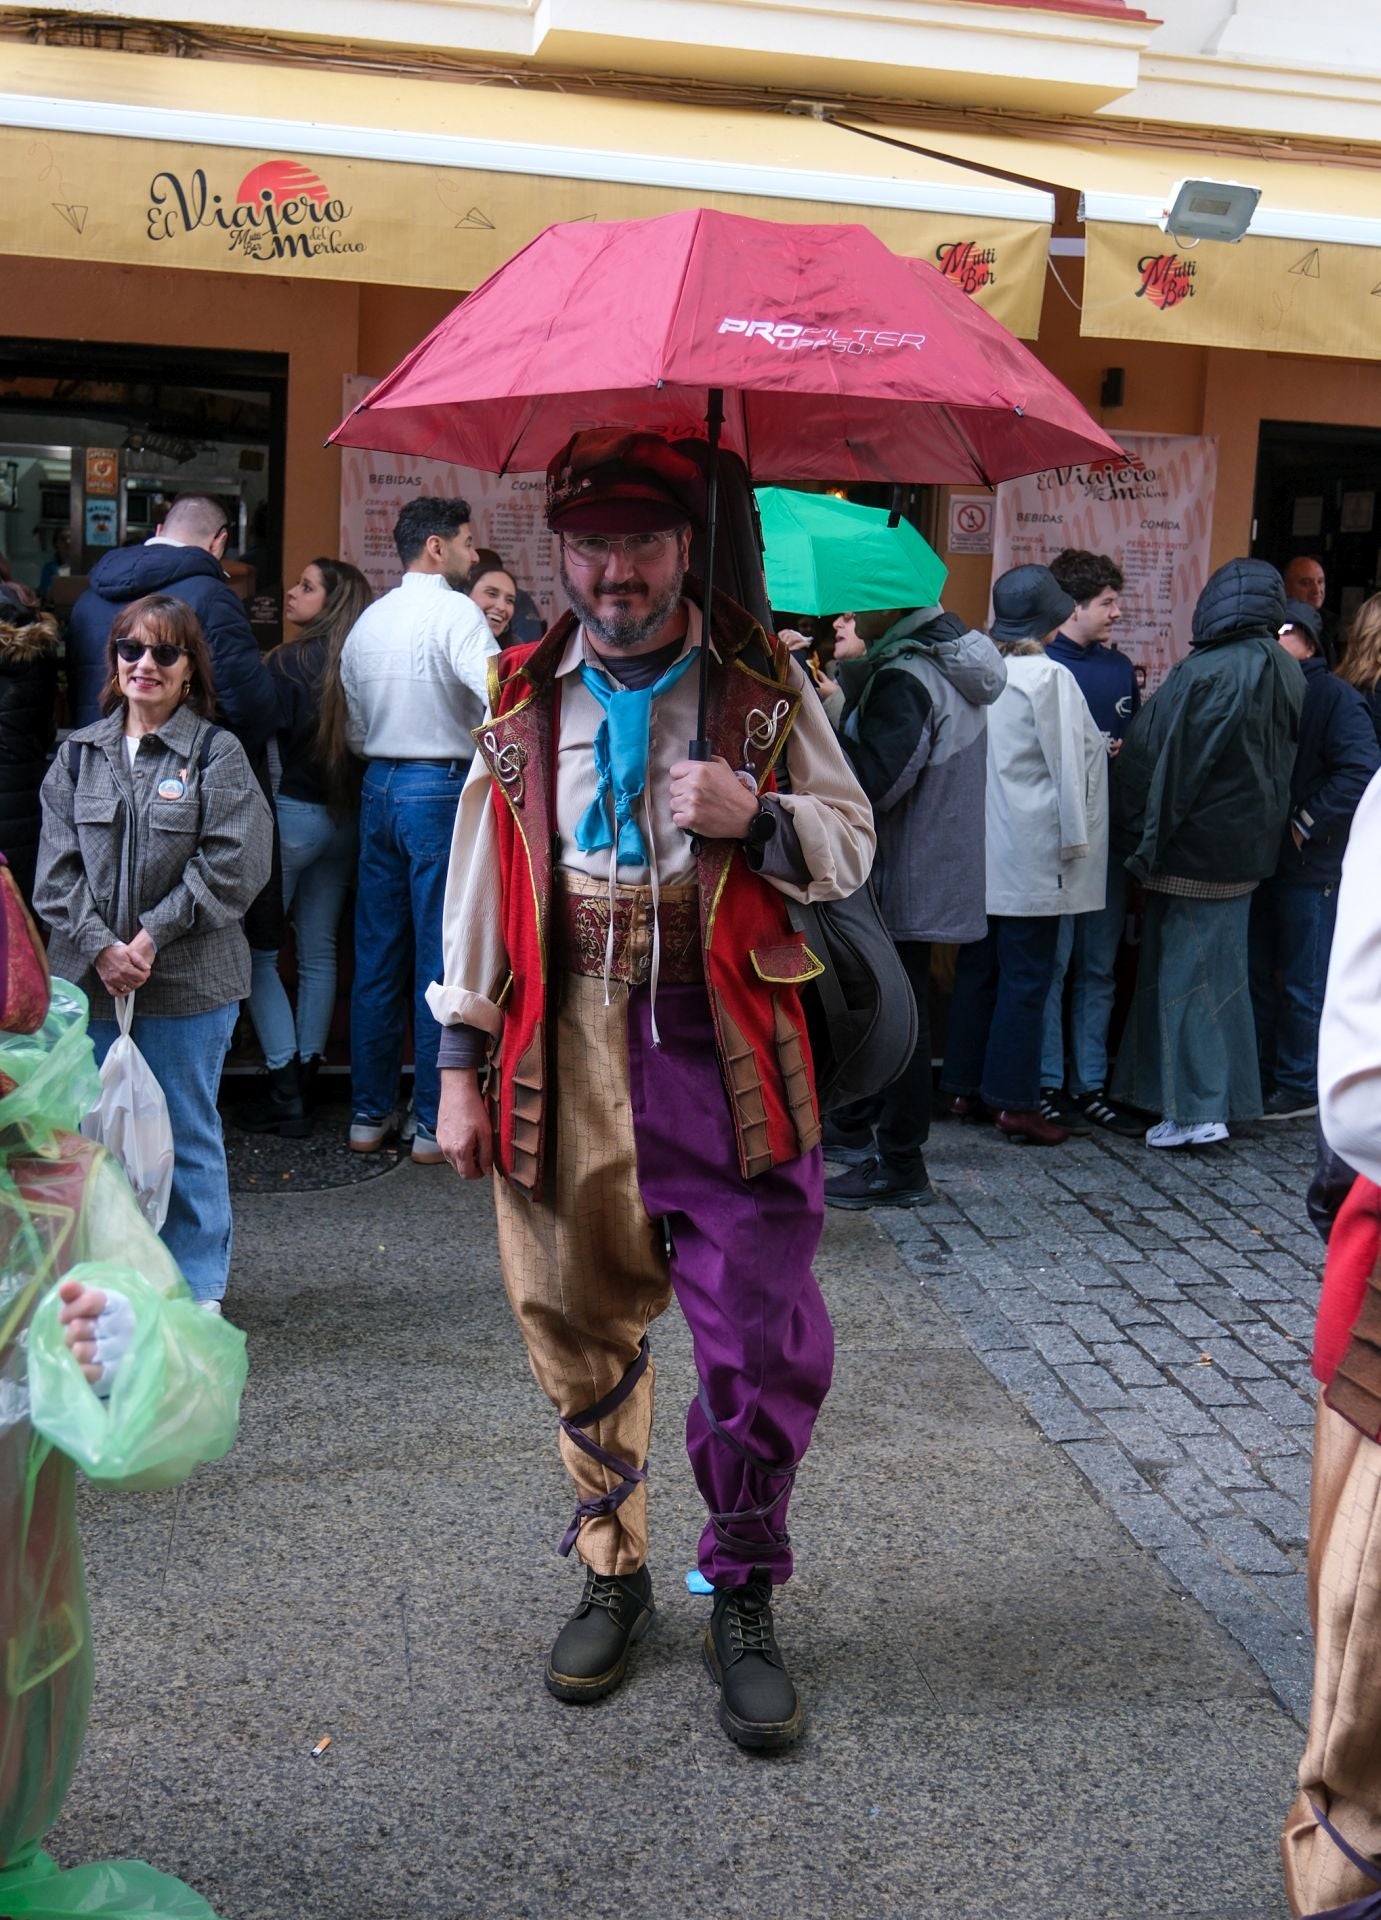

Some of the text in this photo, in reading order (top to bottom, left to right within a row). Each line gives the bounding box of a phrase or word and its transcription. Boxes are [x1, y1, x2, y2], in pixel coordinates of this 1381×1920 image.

[147, 168, 353, 240] El Viajero
[935, 241, 998, 275] Multi
[961, 265, 997, 295] Bar
[1135, 254, 1198, 298] Multi
[1160, 278, 1197, 310] Bar
[719, 317, 926, 350] PROFILTER
[368, 474, 422, 487] BEBIDAS
[1016, 512, 1064, 525] BEBIDAS
